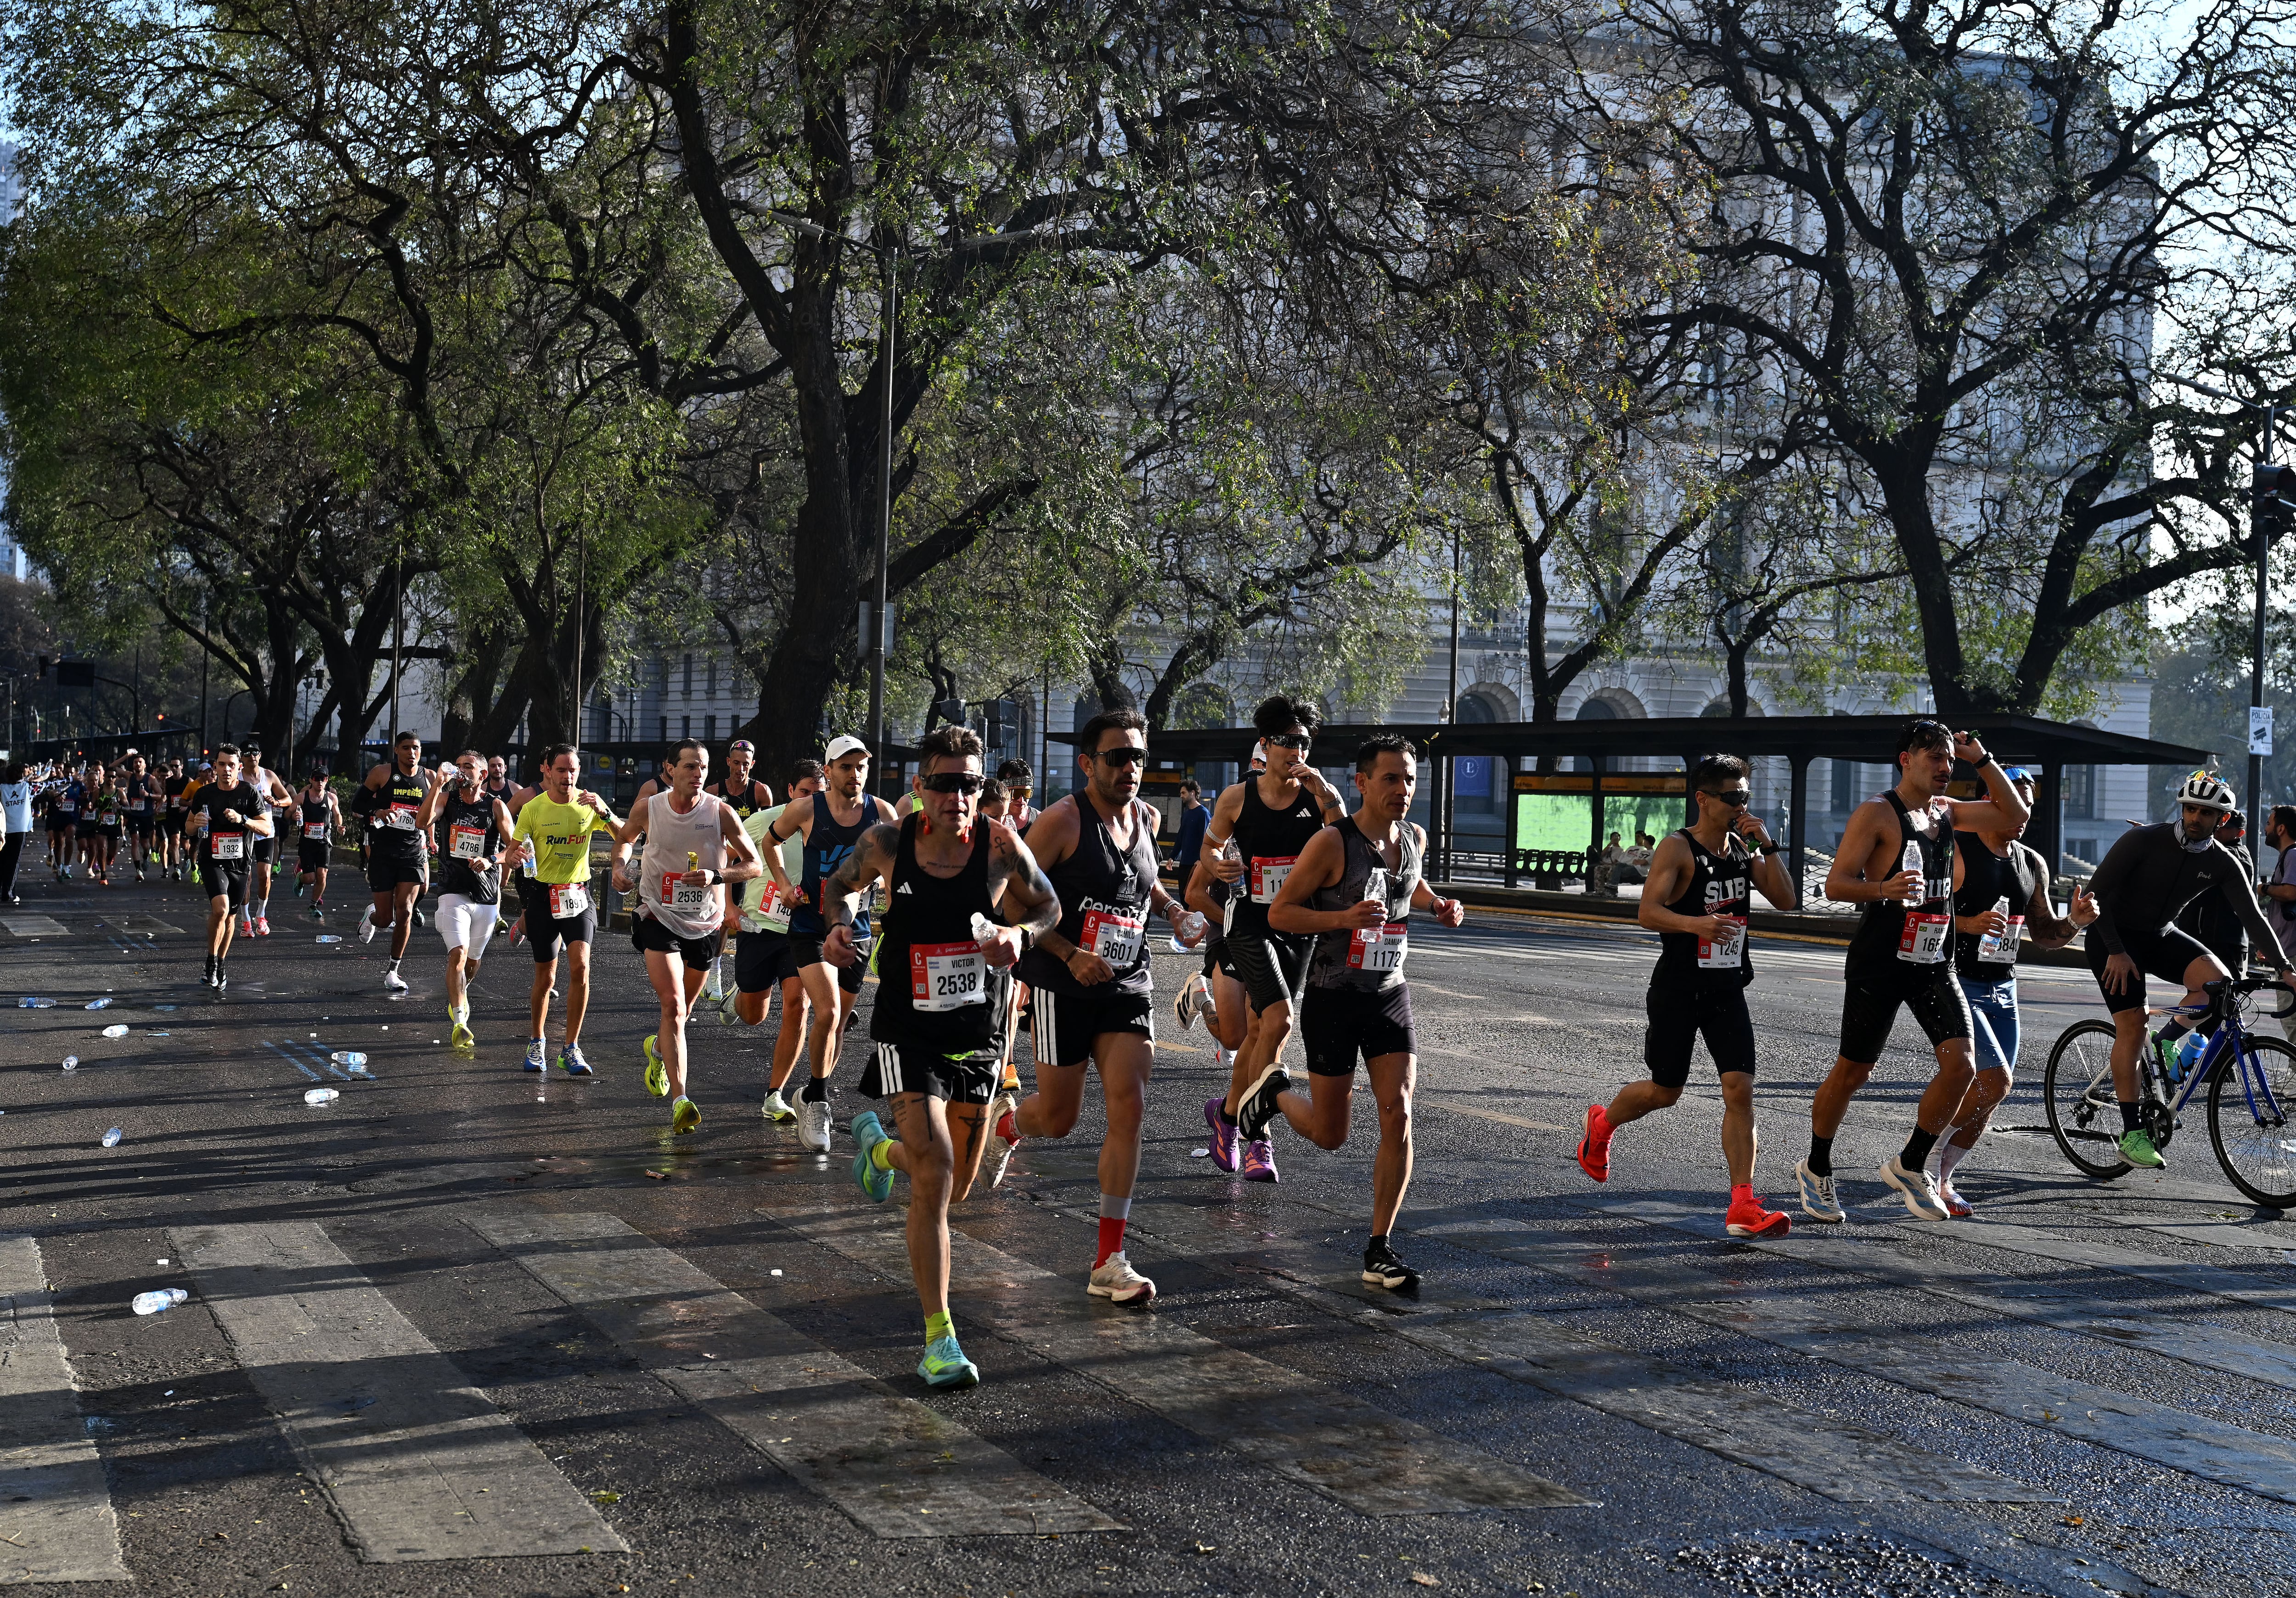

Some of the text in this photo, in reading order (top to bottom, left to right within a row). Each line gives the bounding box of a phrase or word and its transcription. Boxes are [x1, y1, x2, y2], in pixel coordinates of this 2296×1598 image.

[394, 788, 422, 798] IMPERIO
[6, 799, 25, 807] STAFF
[399, 816, 414, 824] 1760
[546, 834, 587, 845] RunFun
[460, 841, 479, 853] 4786
[1254, 862, 1259, 871] C
[666, 876, 670, 885] C
[1704, 877, 1745, 904] SUB
[678, 891, 702, 903] 2536
[565, 898, 583, 909] 1891
[1705, 902, 1721, 915] ELITE
[1088, 916, 1096, 928] C
[1909, 918, 1915, 927] C
[1117, 929, 1135, 939] CAMILO
[1103, 940, 1133, 961] B601
[914, 952, 974, 968] C VICTOR
[1373, 950, 1401, 967] 1172
[937, 972, 976, 995] 2538
